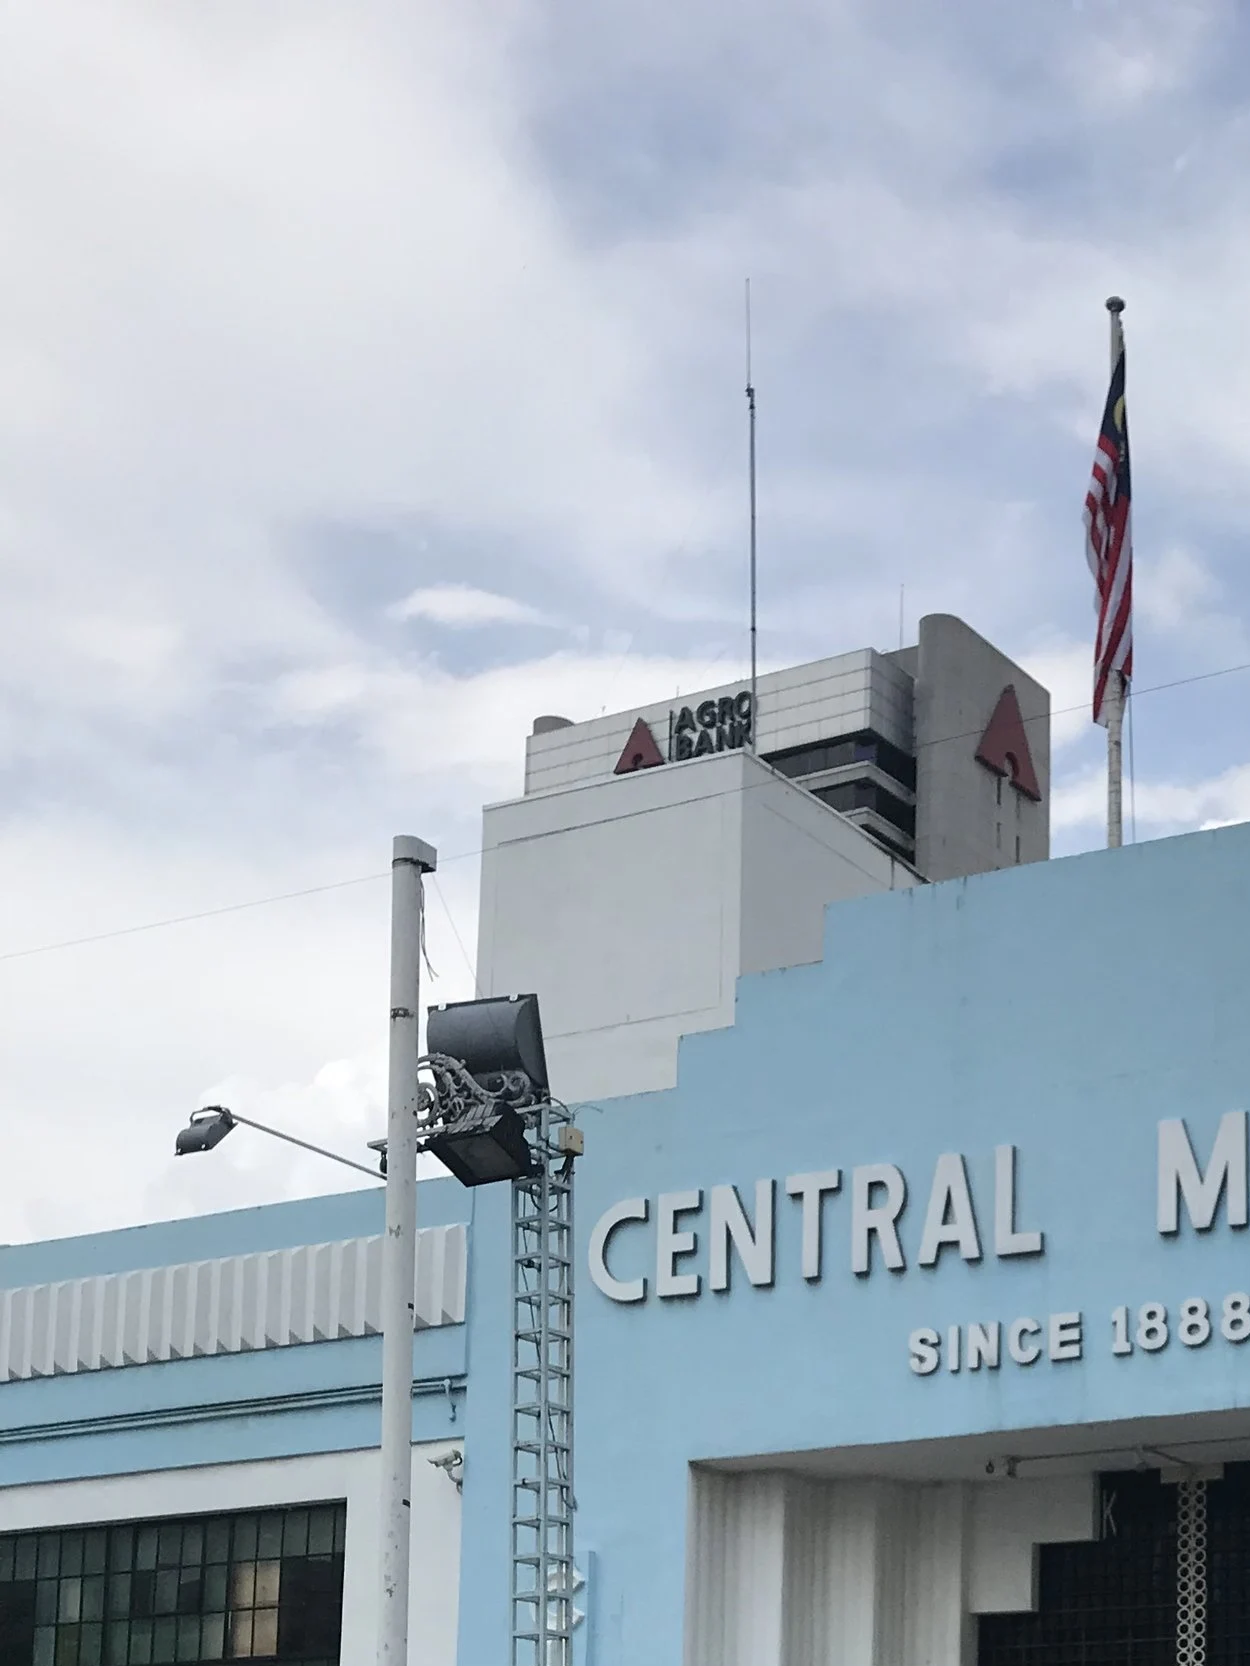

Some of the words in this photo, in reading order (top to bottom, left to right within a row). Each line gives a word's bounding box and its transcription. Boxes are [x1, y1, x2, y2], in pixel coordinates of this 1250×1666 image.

[675, 690, 752, 734] AGRO
[676, 720, 753, 761] BANK
[588, 1144, 1044, 1302] CENTRAL
[908, 1311, 1083, 1375] SINCE
